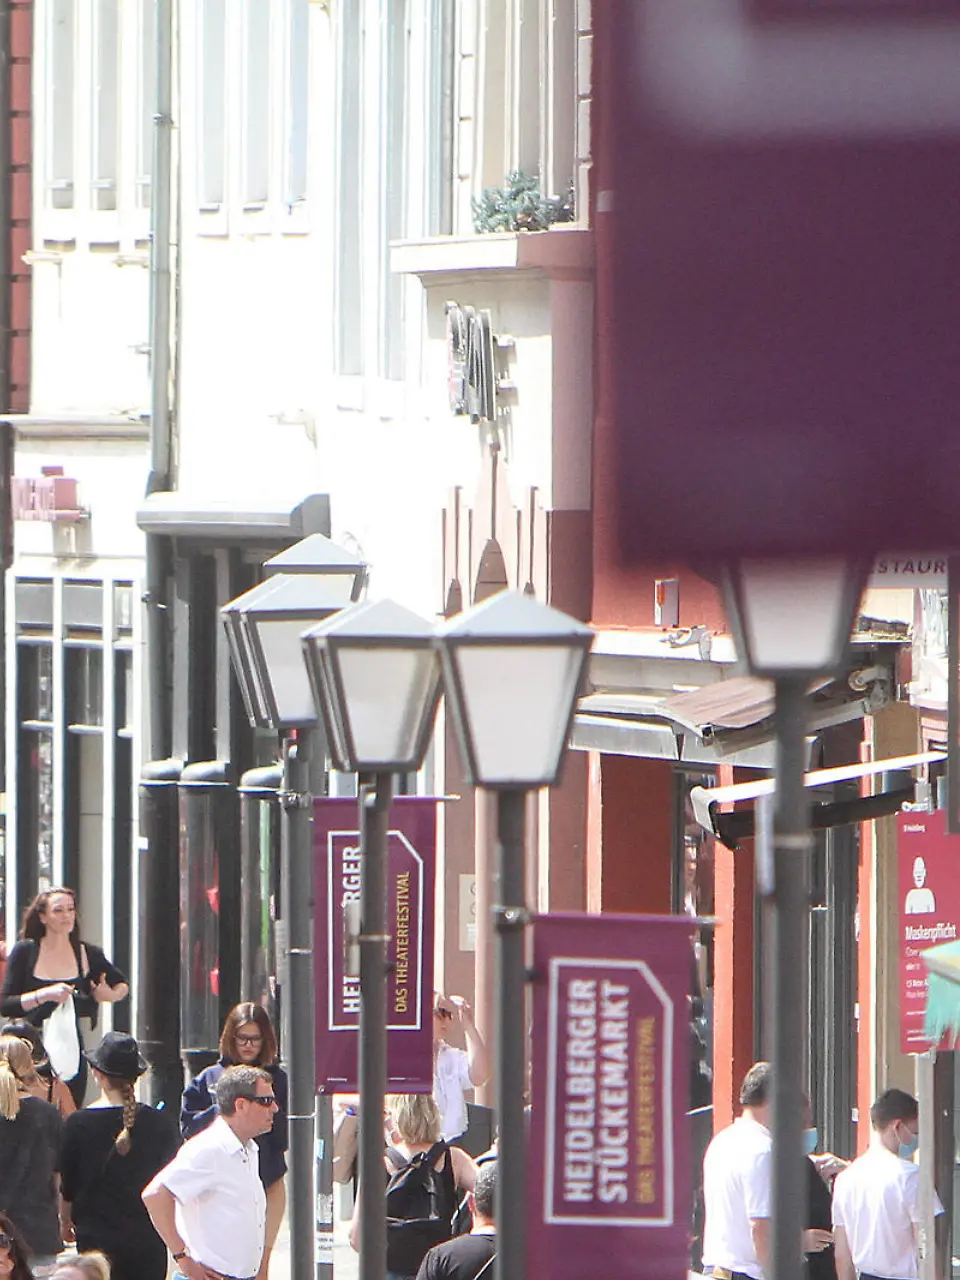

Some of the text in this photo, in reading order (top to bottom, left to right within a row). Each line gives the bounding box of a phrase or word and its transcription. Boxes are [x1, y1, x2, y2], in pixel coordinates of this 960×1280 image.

[877, 558, 947, 574] STAUR
[342, 845, 361, 1014] HEIRGER
[395, 871, 410, 1013] DAS THEATERFESTIVAL
[564, 979, 596, 1203] HEIDELBERGER
[596, 980, 630, 1204] STÜCKEMARKT
